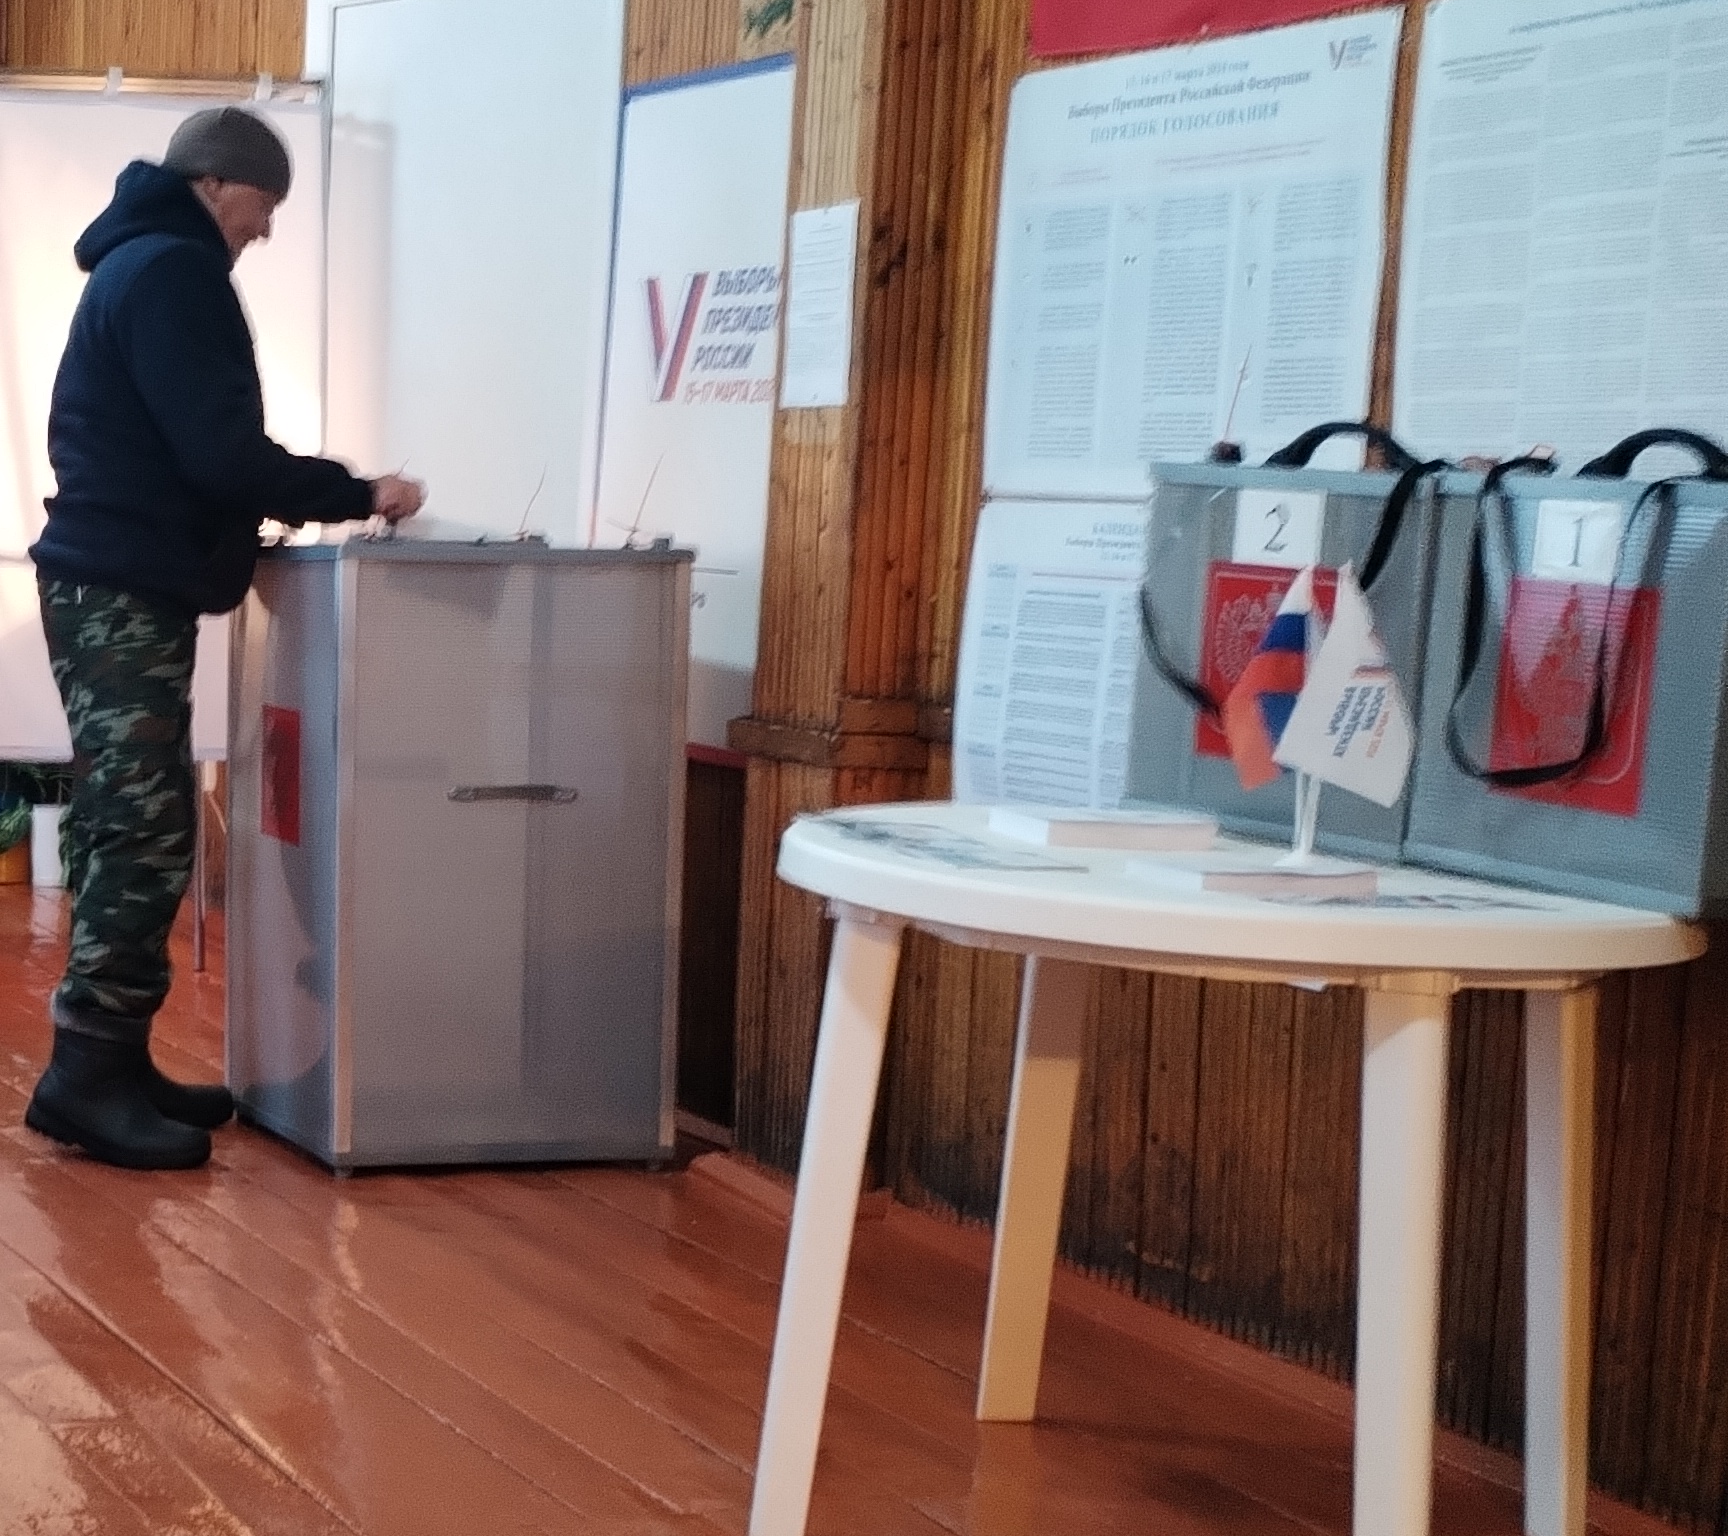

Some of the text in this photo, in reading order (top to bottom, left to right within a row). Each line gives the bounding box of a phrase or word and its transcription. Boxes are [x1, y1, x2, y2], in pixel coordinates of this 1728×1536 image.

[1090, 99, 1280, 144] ПОРЯДОК ГОЛОСОВАНИЯ
[691, 342, 757, 373] РОССИИ
[1263, 502, 1290, 554] 2
[1567, 516, 1585, 568] 1
